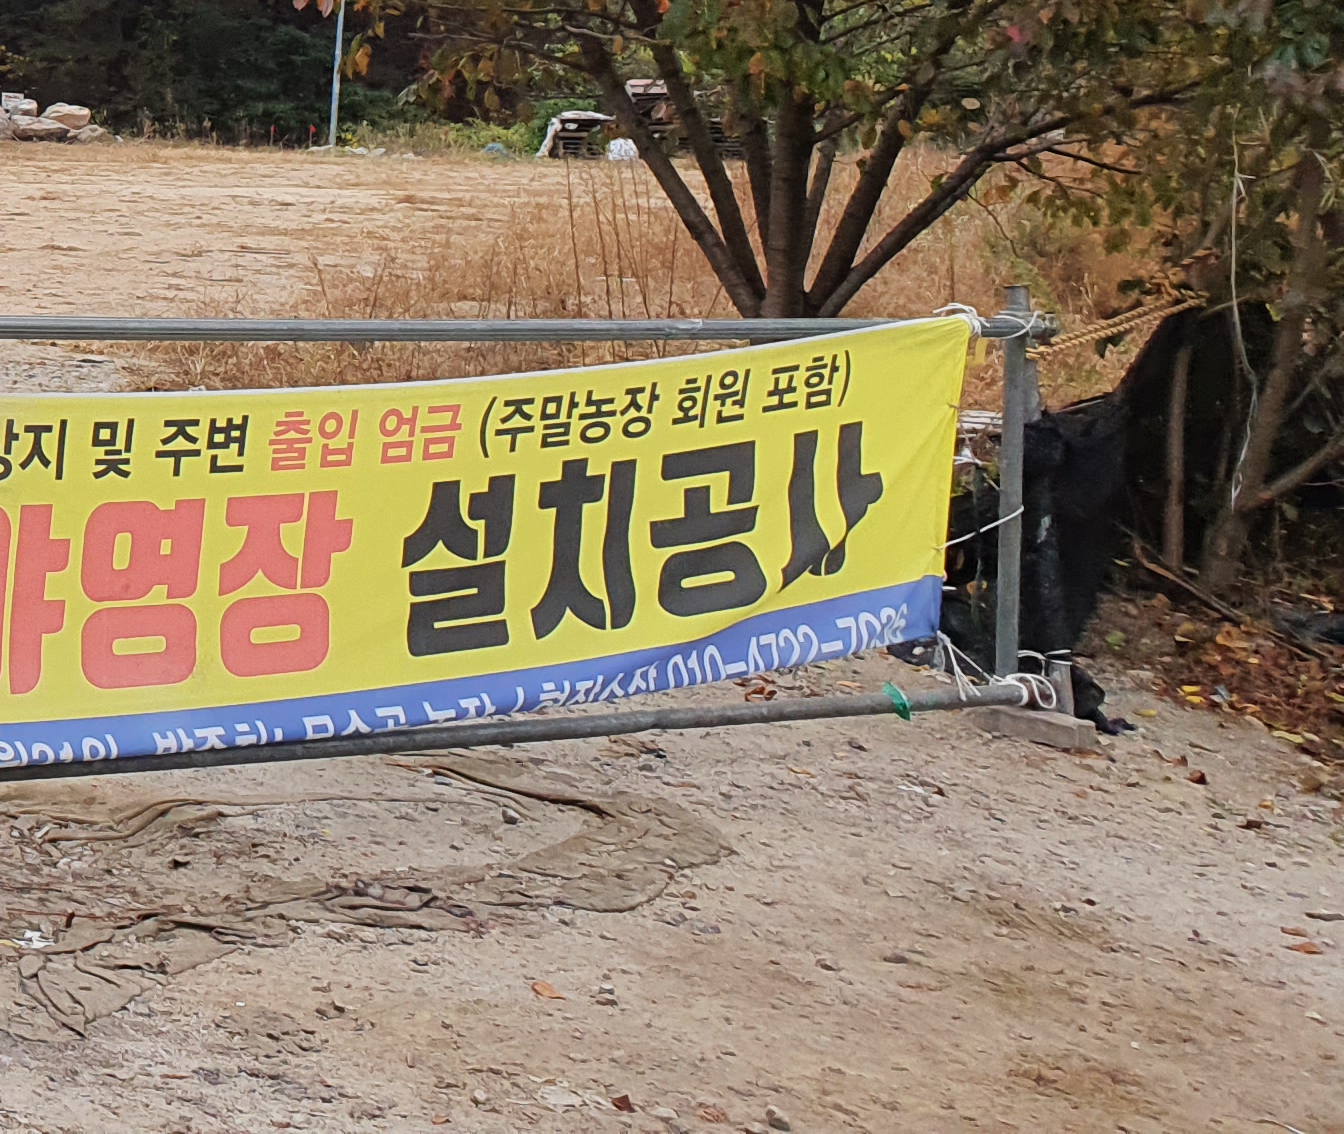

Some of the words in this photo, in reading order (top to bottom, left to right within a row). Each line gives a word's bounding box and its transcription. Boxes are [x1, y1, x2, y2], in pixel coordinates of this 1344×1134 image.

[91, 419, 134, 479] 및
[155, 415, 249, 476] 주변
[269, 411, 358, 471] 출입
[379, 404, 462, 464] 엄금
[480, 382, 660, 458] (주말농장
[672, 369, 751, 428] 회원
[762, 350, 852, 413] 포함)
[401, 421, 883, 657] 설치공사
